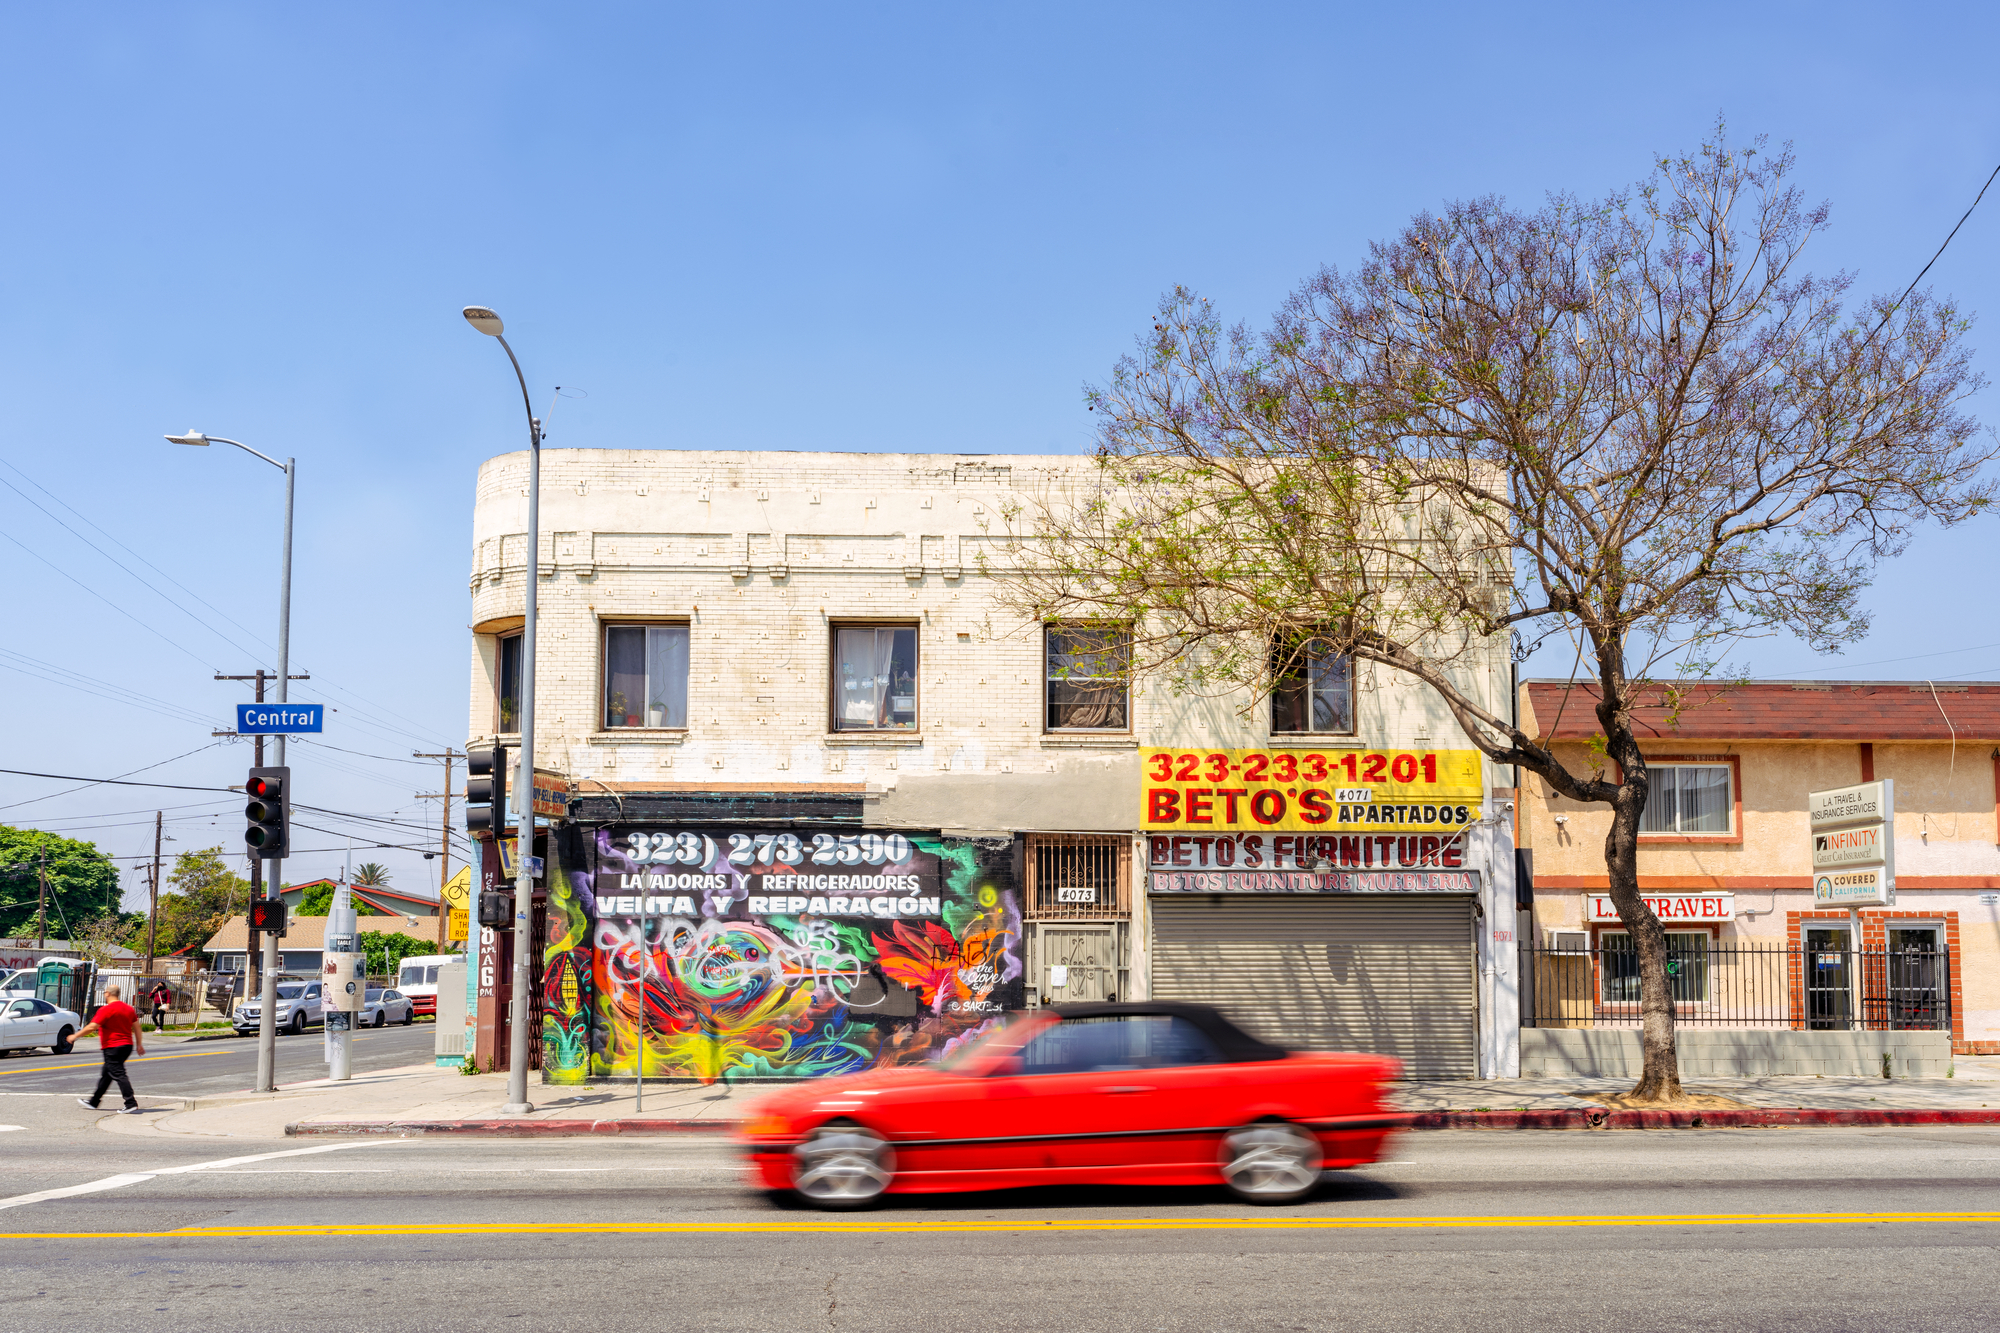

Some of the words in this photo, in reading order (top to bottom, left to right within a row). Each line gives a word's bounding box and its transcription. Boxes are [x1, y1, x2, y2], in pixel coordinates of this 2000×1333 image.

[245, 709, 315, 726] Central
[1148, 753, 1437, 783] 323-233-1201
[1338, 789, 1369, 801] 4071
[1823, 798, 1833, 807] L.A.
[1834, 793, 1857, 806] TRAVEL
[1858, 791, 1863, 802] &
[1147, 787, 1334, 826] BETO'S
[1337, 804, 1470, 825] APARTADOS
[1811, 806, 1845, 821] INSURANCE
[1845, 802, 1877, 816] SERVICES
[1827, 829, 1877, 850] INFINITY
[727, 832, 913, 867] 273-2590
[1151, 832, 1264, 868] BETO'S
[1273, 835, 1464, 869] FURNITURE
[1832, 851, 1843, 862] CAR
[735, 873, 752, 891] Y
[762, 873, 920, 892] REFRIGERADORES
[1226, 871, 1353, 892] FURNITURE
[1357, 871, 1475, 891] MUEBLERIA
[1834, 874, 1876, 886] COVERED
[1061, 889, 1092, 901] 4073
[1834, 886, 1876, 895] CALIFORNIA
[595, 896, 698, 916] VENTA
[712, 896, 735, 916] Y
[1596, 898, 1621, 917] L.
[1642, 898, 1729, 917] TRAVEL
[453, 912, 469, 920] SHA
[455, 930, 468, 938] ROA
[481, 966, 494, 987] 6
